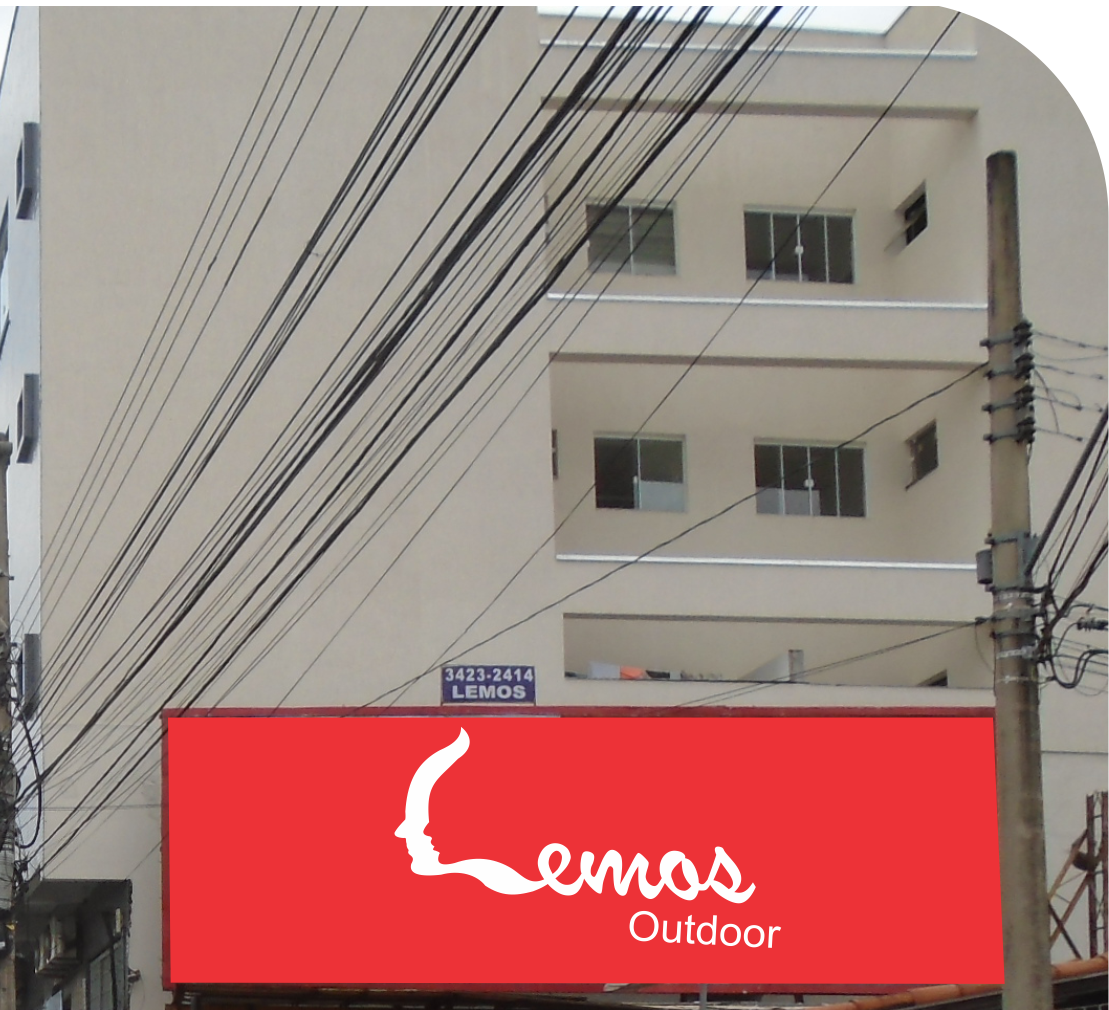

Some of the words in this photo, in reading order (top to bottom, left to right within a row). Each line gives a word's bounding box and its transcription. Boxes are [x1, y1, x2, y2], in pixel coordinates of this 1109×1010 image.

[445, 667, 533, 682] 3423-2414
[452, 685, 526, 699] LEMOS
[394, 726, 756, 904] Lemos
[629, 910, 782, 949] Outdoor
